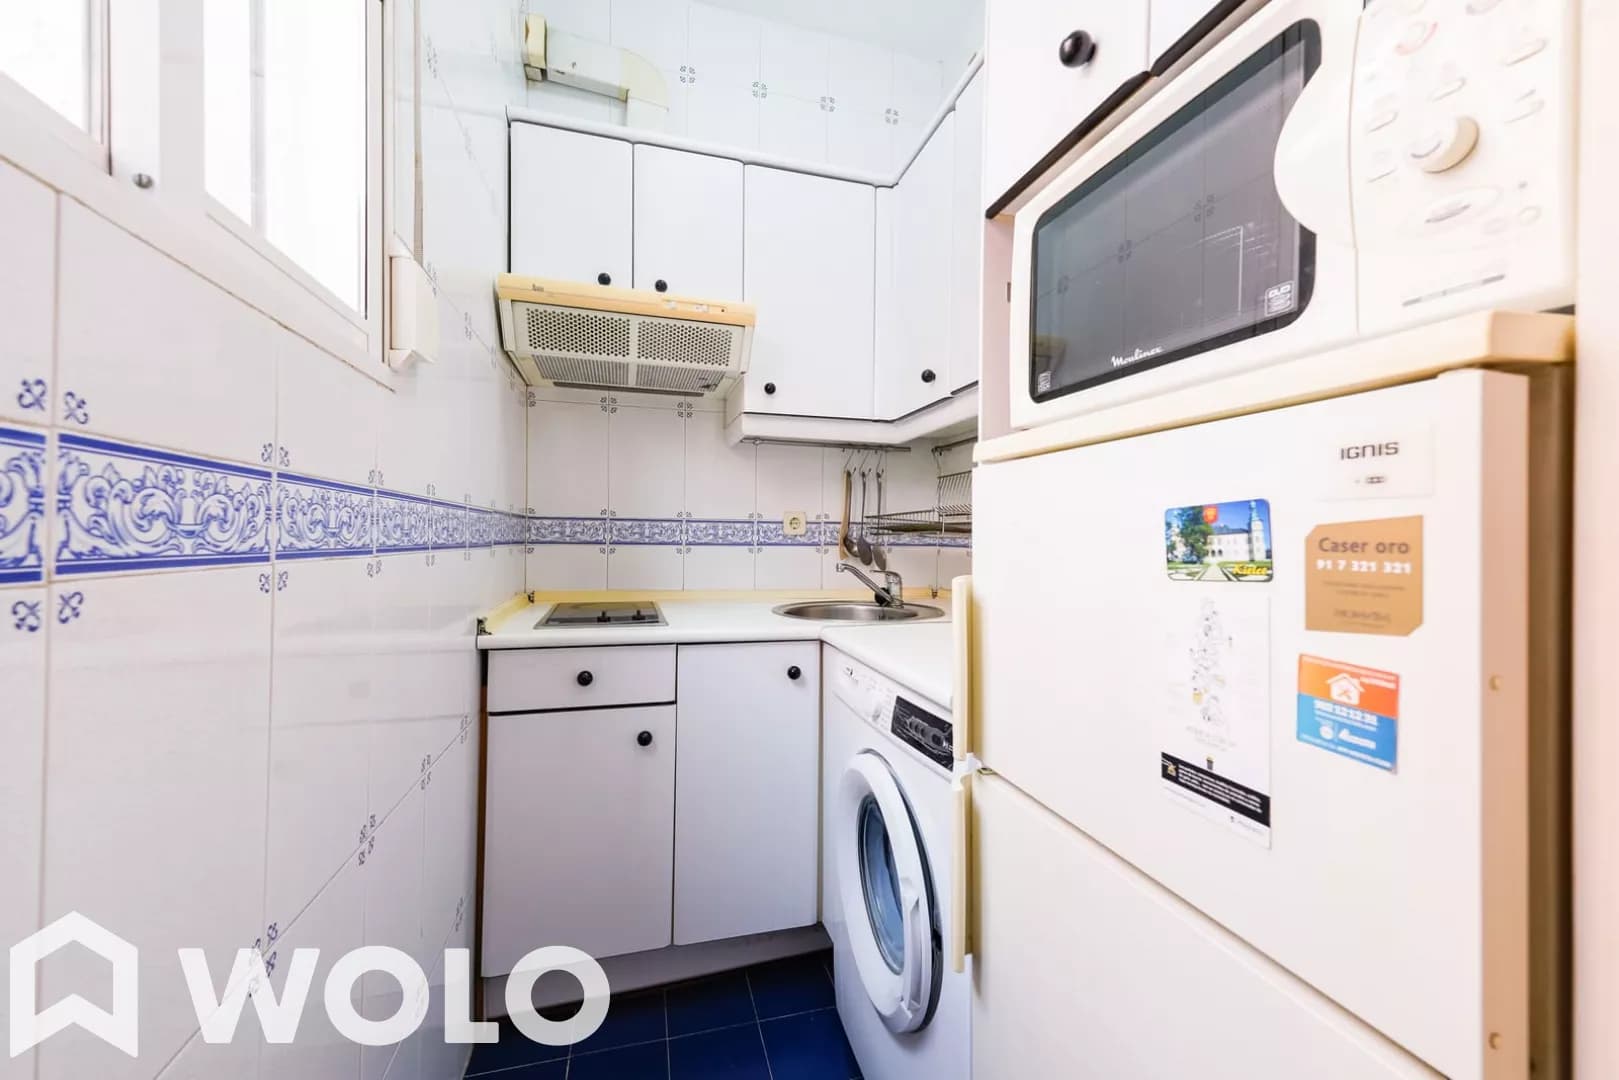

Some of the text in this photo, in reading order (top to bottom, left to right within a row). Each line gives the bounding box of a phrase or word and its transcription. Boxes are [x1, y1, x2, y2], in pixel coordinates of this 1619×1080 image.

[1111, 347, 1162, 368] Moulinex
[1340, 441, 1399, 461] IGNIS
[1318, 537, 1411, 555] Caser oro
[1316, 559, 1333, 571] 91
[1337, 559, 1348, 572] 7
